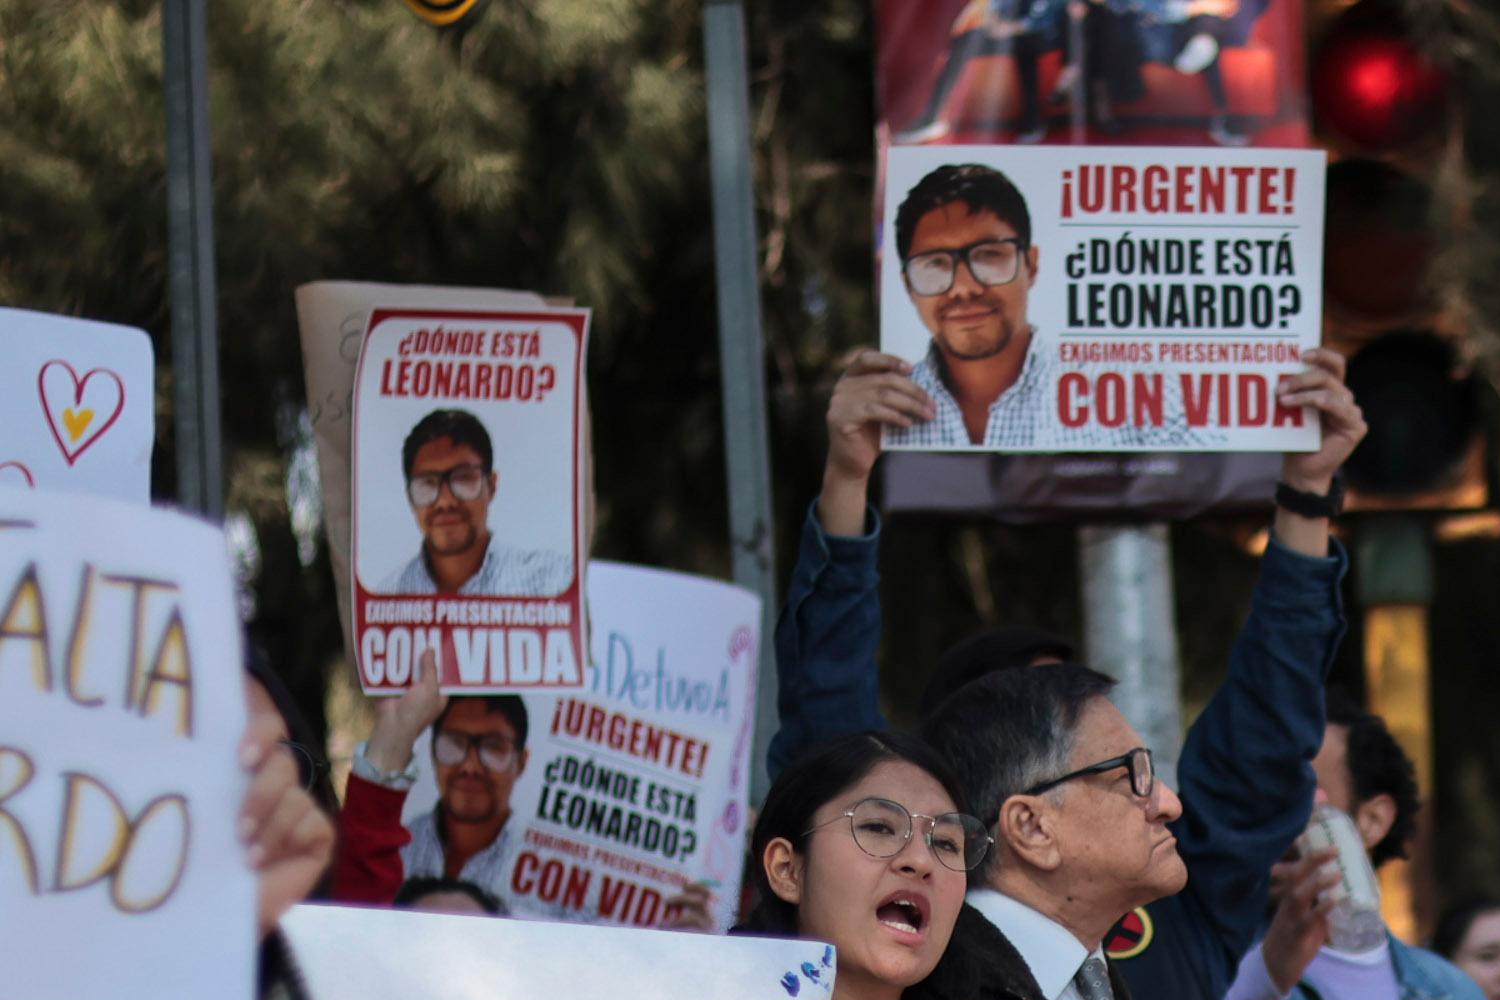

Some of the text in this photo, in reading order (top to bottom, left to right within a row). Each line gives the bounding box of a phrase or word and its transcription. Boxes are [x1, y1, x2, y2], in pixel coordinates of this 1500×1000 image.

[1060, 164, 1297, 218] ¡URGENTE!
[1064, 232, 1295, 279] ¿DÓNDE ESTÁ
[1066, 283, 1301, 329] LEONARDO?
[399, 327, 484, 358] ¿DÓNDE
[490, 330, 541, 358] ESTÁ
[1059, 339, 1300, 363] EXIGIMOS PRESENTACIÓN
[380, 358, 557, 402] LEONARDO?
[1056, 371, 1164, 429] CON
[364, 599, 572, 627] EXIGIMOS PRESENTACIÓN
[361, 626, 580, 687] CON VIDA
[551, 698, 710, 779] ¡URGENTE!
[544, 755, 698, 824] ¿DÓNDE ESTÁ
[536, 785, 698, 863] LEONARDO?
[510, 851, 592, 912] CON
